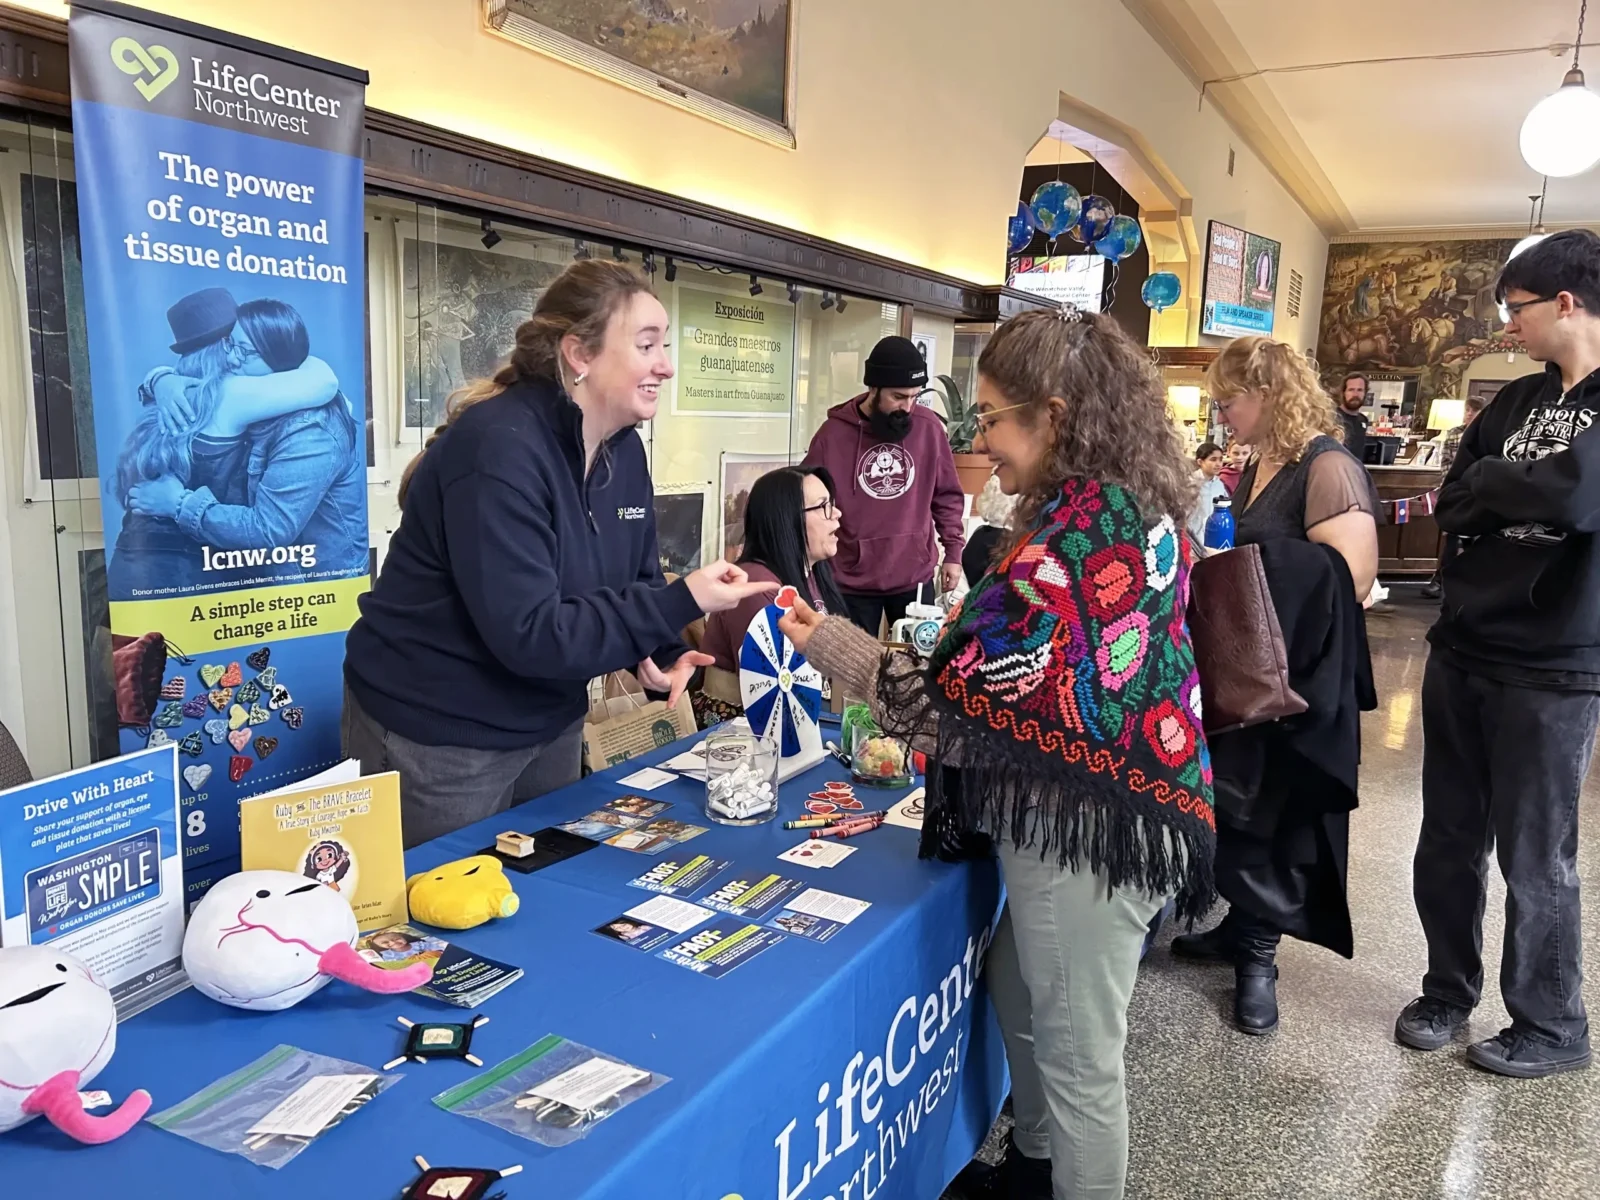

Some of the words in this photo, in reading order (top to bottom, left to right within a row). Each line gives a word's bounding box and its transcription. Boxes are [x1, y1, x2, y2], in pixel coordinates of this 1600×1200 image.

[191, 57, 341, 118] LifeCenter
[193, 88, 309, 135] Northwest
[159, 151, 218, 187] The
[224, 170, 314, 204] power
[147, 195, 183, 222] of
[188, 207, 272, 238] organ
[278, 219, 329, 244] and
[124, 232, 220, 268] tissue
[226, 245, 347, 284] donation
[714, 301, 764, 322] Exposición
[694, 328, 738, 348] Grandes
[739, 336, 781, 352] maestros
[700, 355, 775, 374] guanajuatenses
[685, 386, 715, 398] Masters
[715, 388, 723, 398] in
[723, 389, 734, 399] art
[734, 388, 750, 399] from
[750, 391, 785, 402] Guanajuato
[1524, 408, 1598, 429] FMOS
[202, 543, 316, 572] lcnw.org
[132, 588, 153, 596] Donor
[154, 587, 177, 595] mother
[178, 585, 195, 593] Laura
[196, 583, 214, 591] Givens
[214, 580, 240, 589] embraces
[240, 577, 255, 585] Linda
[284, 572, 306, 580] recipient
[190, 605, 205, 622] A
[208, 598, 265, 620] simple
[268, 595, 304, 612] step
[308, 592, 336, 606] can
[213, 622, 274, 641] change
[277, 621, 286, 631] a
[290, 613, 318, 629] life
[654, 726, 673, 740] WHOLE
[23, 797, 69, 821] Drive
[71, 782, 110, 805] With
[113, 769, 155, 793] Heart
[181, 796, 195, 806] up
[197, 792, 209, 802] to
[275, 803, 293, 819] Ruby
[309, 798, 320, 810] The
[322, 792, 344, 808] BRAVE
[345, 788, 372, 804] Bracelet
[31, 835, 47, 848] and
[48, 829, 70, 842] tissue
[71, 819, 104, 836] donation
[105, 811, 122, 824] with
[128, 802, 151, 815] license
[33, 822, 56, 835] Share
[56, 815, 75, 829] your
[75, 808, 104, 825] support
[105, 803, 113, 814] of
[113, 798, 136, 811] organ,
[136, 792, 148, 803] eye
[186, 810, 207, 837] 8
[280, 821, 284, 829] A
[285, 820, 296, 828] True
[296, 816, 310, 827] Story
[311, 816, 316, 824] of
[55, 838, 75, 853] plate
[75, 833, 92, 844] that
[93, 827, 113, 839] saves
[113, 819, 132, 833] lives!
[309, 828, 320, 838] Ruby
[185, 843, 210, 857] lives
[37, 853, 112, 888] WASHINGTON
[79, 850, 153, 909] SMPLE
[638, 861, 679, 884] FACT
[188, 878, 211, 892] over
[707, 880, 750, 904] FACT
[48, 893, 67, 908] LIFE
[60, 917, 83, 930] ORGAN
[84, 905, 111, 920] DONORS
[112, 898, 127, 910] SAVE
[128, 892, 146, 903] LIVES
[671, 929, 722, 957] FACT
[808, 1028, 963, 1200] rthwest
